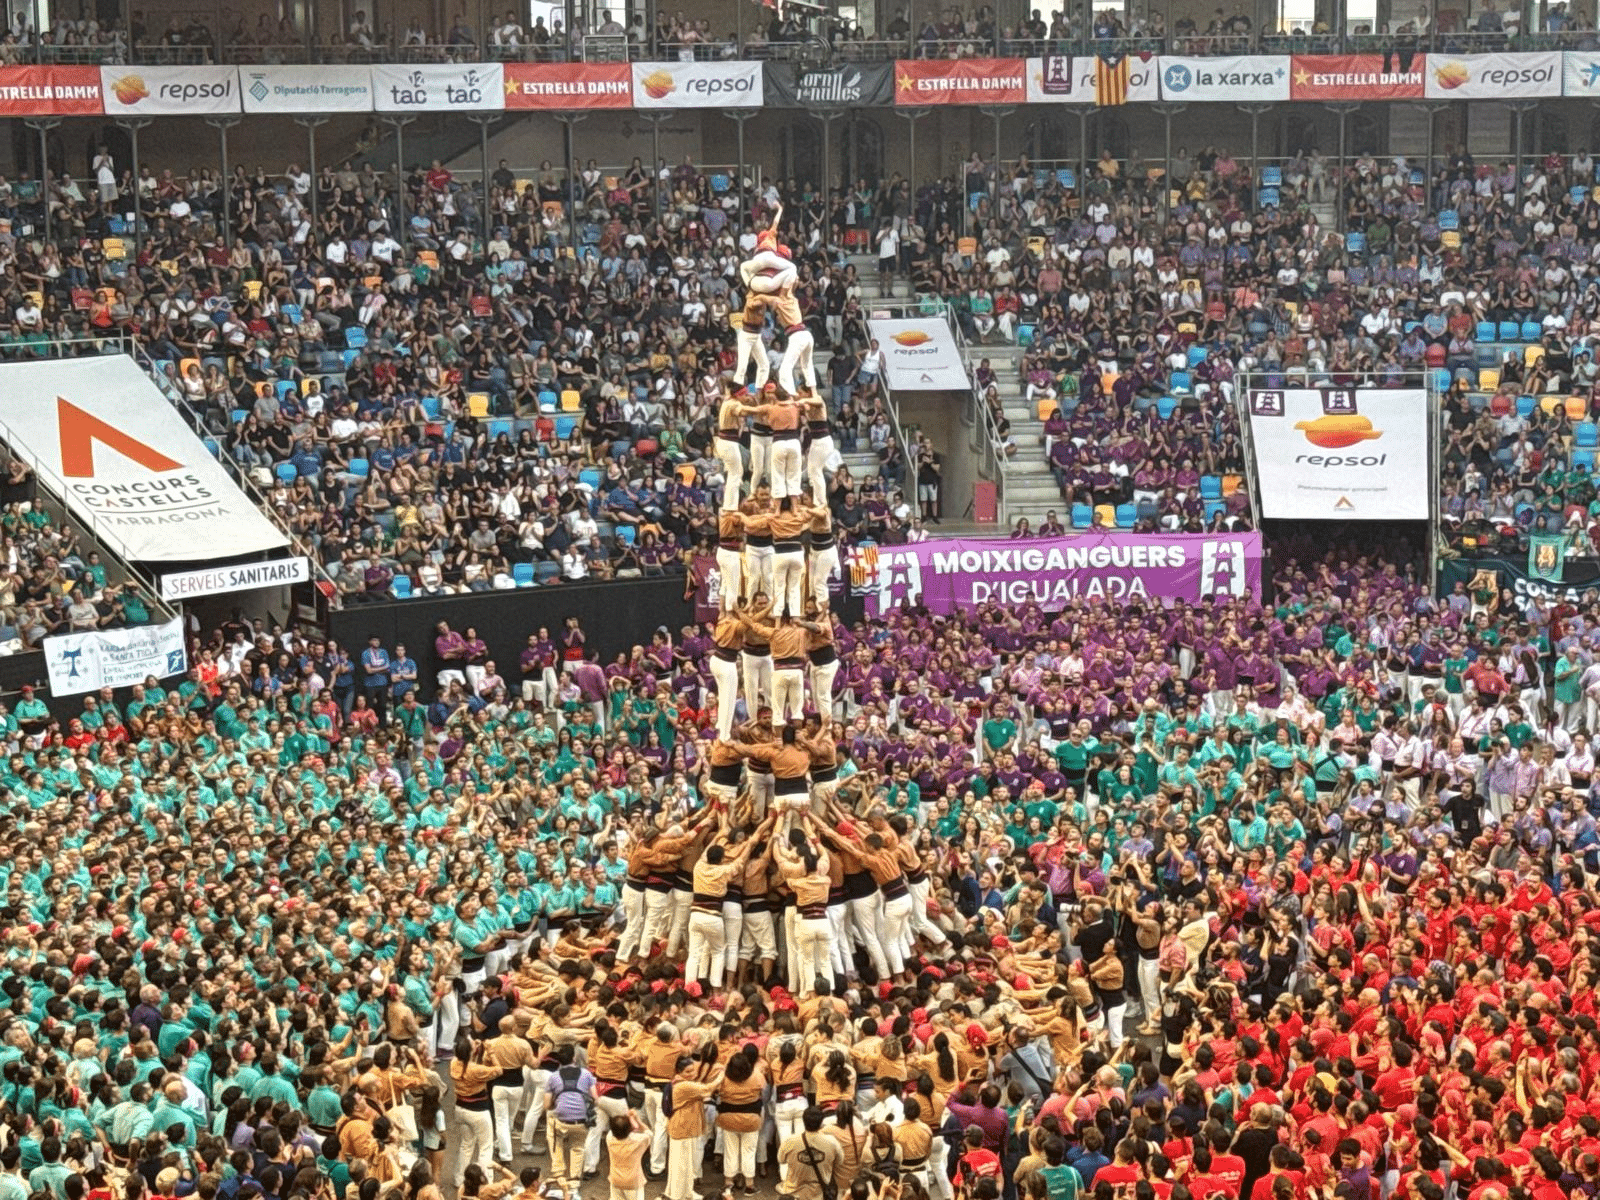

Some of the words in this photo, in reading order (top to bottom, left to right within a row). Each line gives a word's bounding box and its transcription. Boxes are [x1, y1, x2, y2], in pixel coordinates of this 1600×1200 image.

[685, 75, 755, 97] repsol
[917, 79, 980, 92] ESTRELLA
[981, 76, 1023, 91] DAMM
[1196, 68, 1213, 86] la
[1313, 72, 1377, 86] ESTRELLA
[1380, 72, 1422, 85] DAMM
[1480, 64, 1554, 87] repsol
[0, 86, 53, 100] TRELLA
[55, 85, 99, 100] DAMM
[160, 79, 231, 102] repsol
[390, 84, 427, 105] tac
[445, 84, 482, 104] tac
[523, 82, 586, 95] ESTRELLA
[588, 81, 629, 95] DAMM
[894, 347, 939, 356] repsol
[1295, 453, 1387, 468] repsol
[72, 474, 201, 496] CONCURS
[84, 487, 213, 508] CASTELLS
[101, 506, 231, 528] TARRAGONA
[932, 545, 1187, 575] MOIXIGANGUERS
[171, 568, 226, 595] SERVEIS
[229, 562, 300, 587] SANITARIS
[971, 576, 1148, 605] D'IGUALADA
